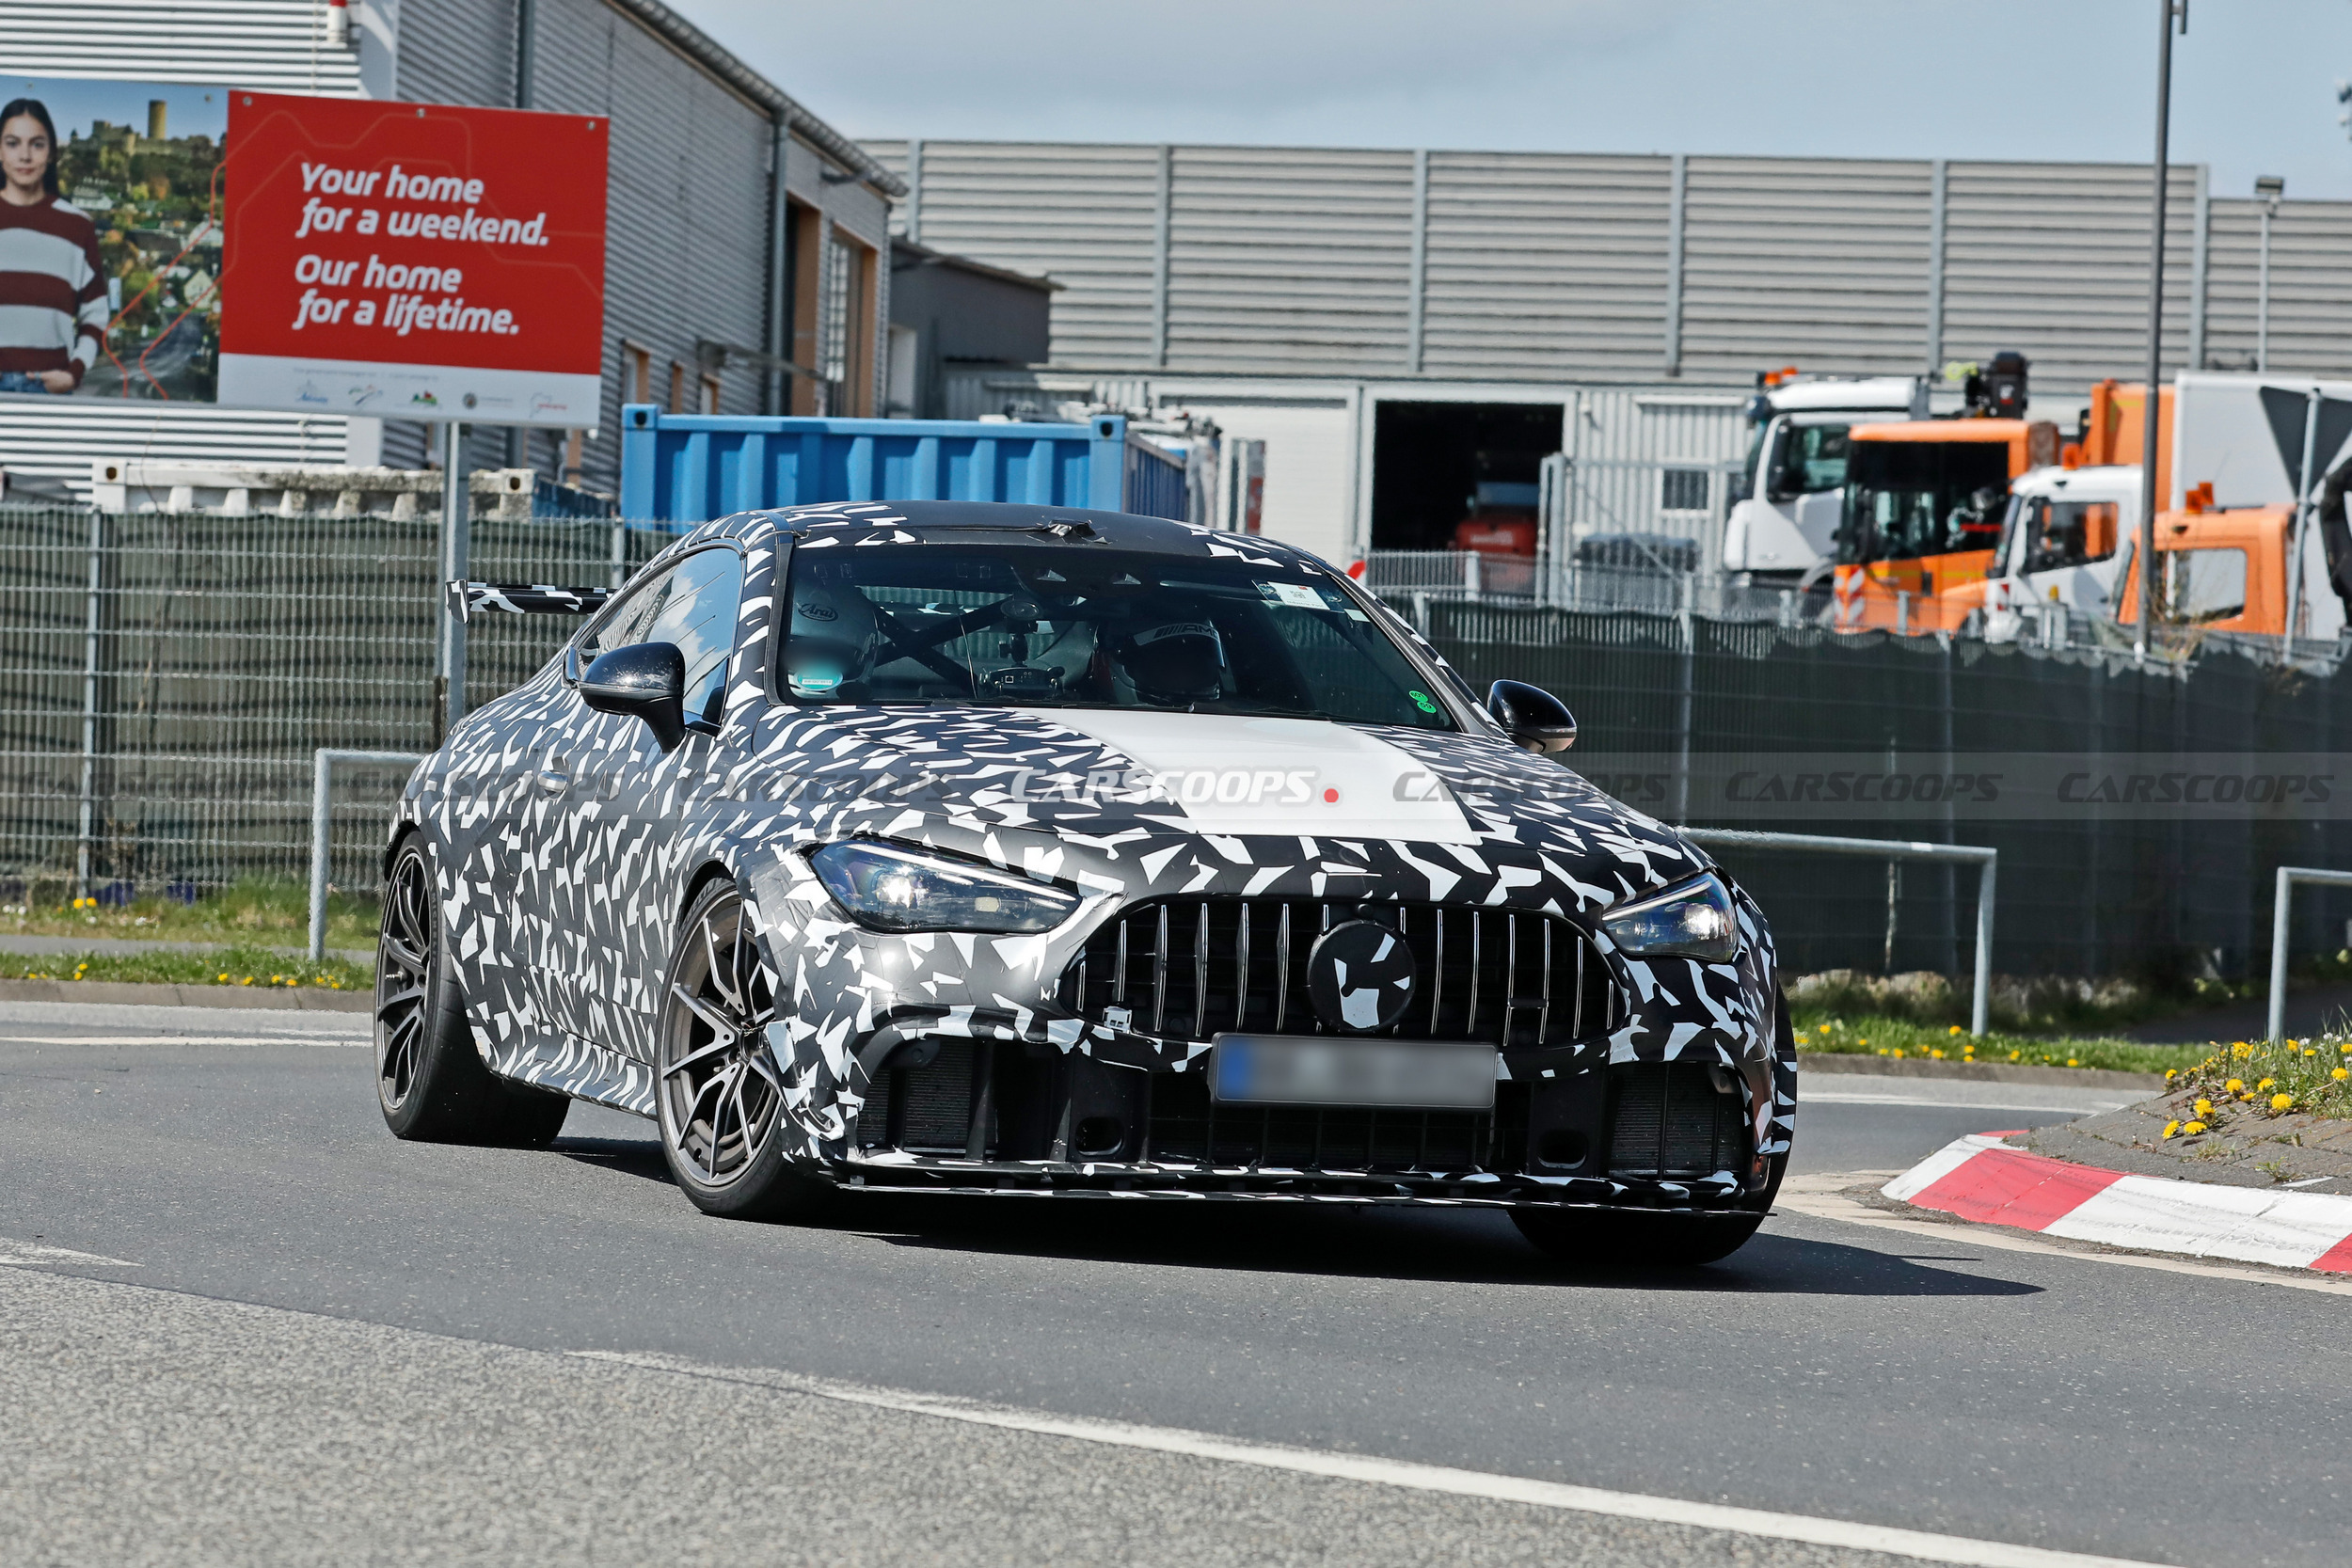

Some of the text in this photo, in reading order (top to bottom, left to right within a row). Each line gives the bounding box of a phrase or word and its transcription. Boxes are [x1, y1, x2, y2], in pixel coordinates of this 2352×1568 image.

[301, 162, 485, 204] Your home
[294, 197, 548, 246] for a weekend.
[294, 253, 463, 293] Our home
[292, 288, 520, 336] for a lifetime.
[801, 604, 834, 618] Arai
